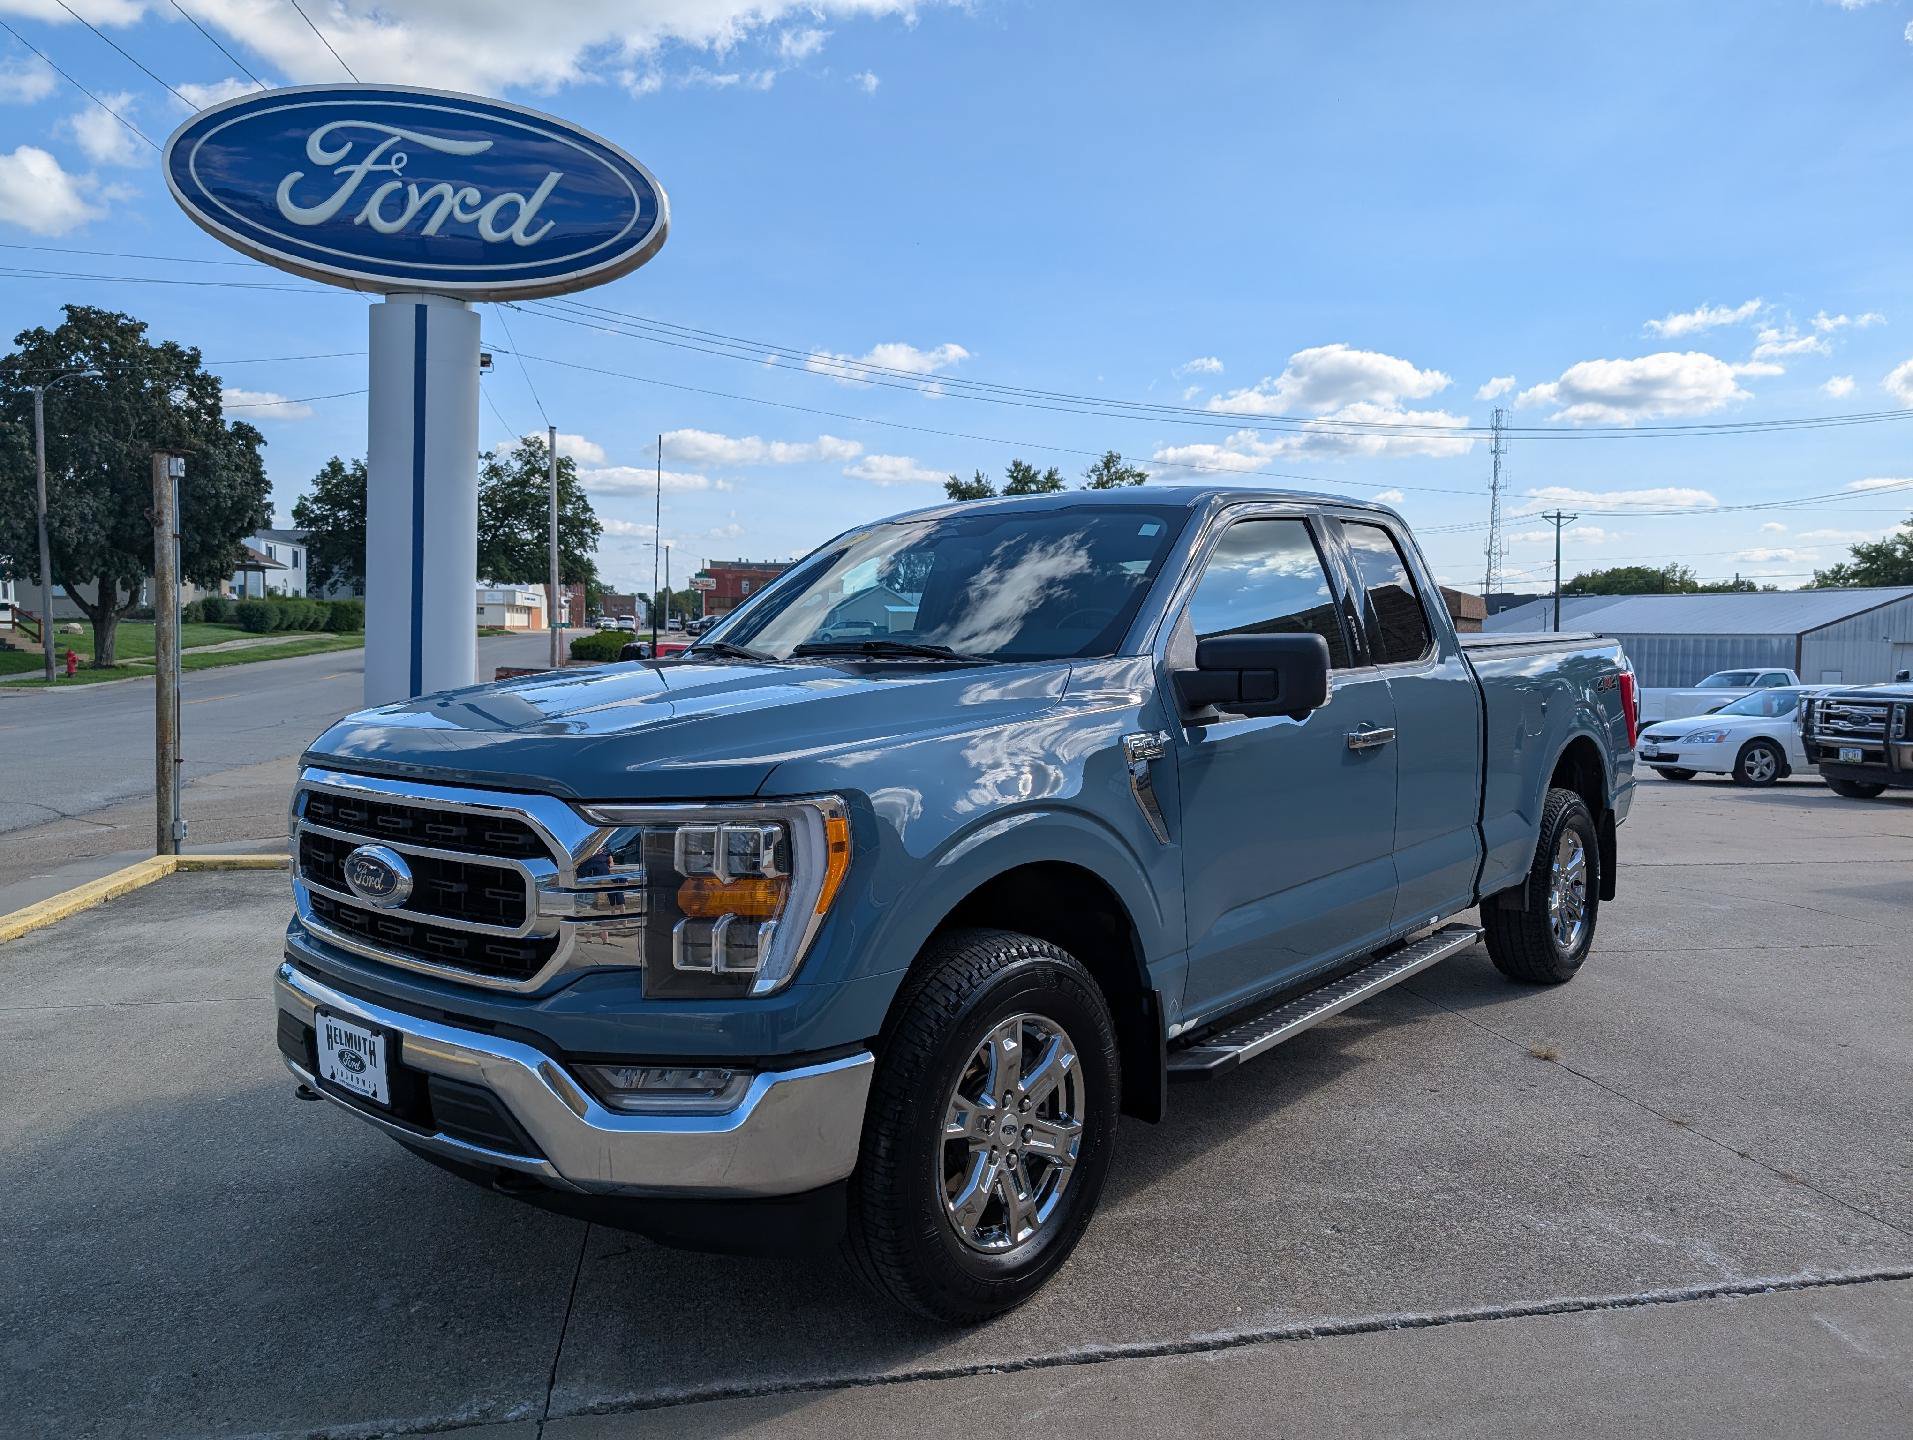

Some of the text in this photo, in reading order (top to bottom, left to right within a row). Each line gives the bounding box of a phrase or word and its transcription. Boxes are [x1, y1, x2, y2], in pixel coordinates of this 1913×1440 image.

[276, 119, 564, 247] Ford
[353, 861, 385, 891] Ford
[326, 1023, 378, 1068] HELMUTH
[342, 1051, 362, 1071] Ford
